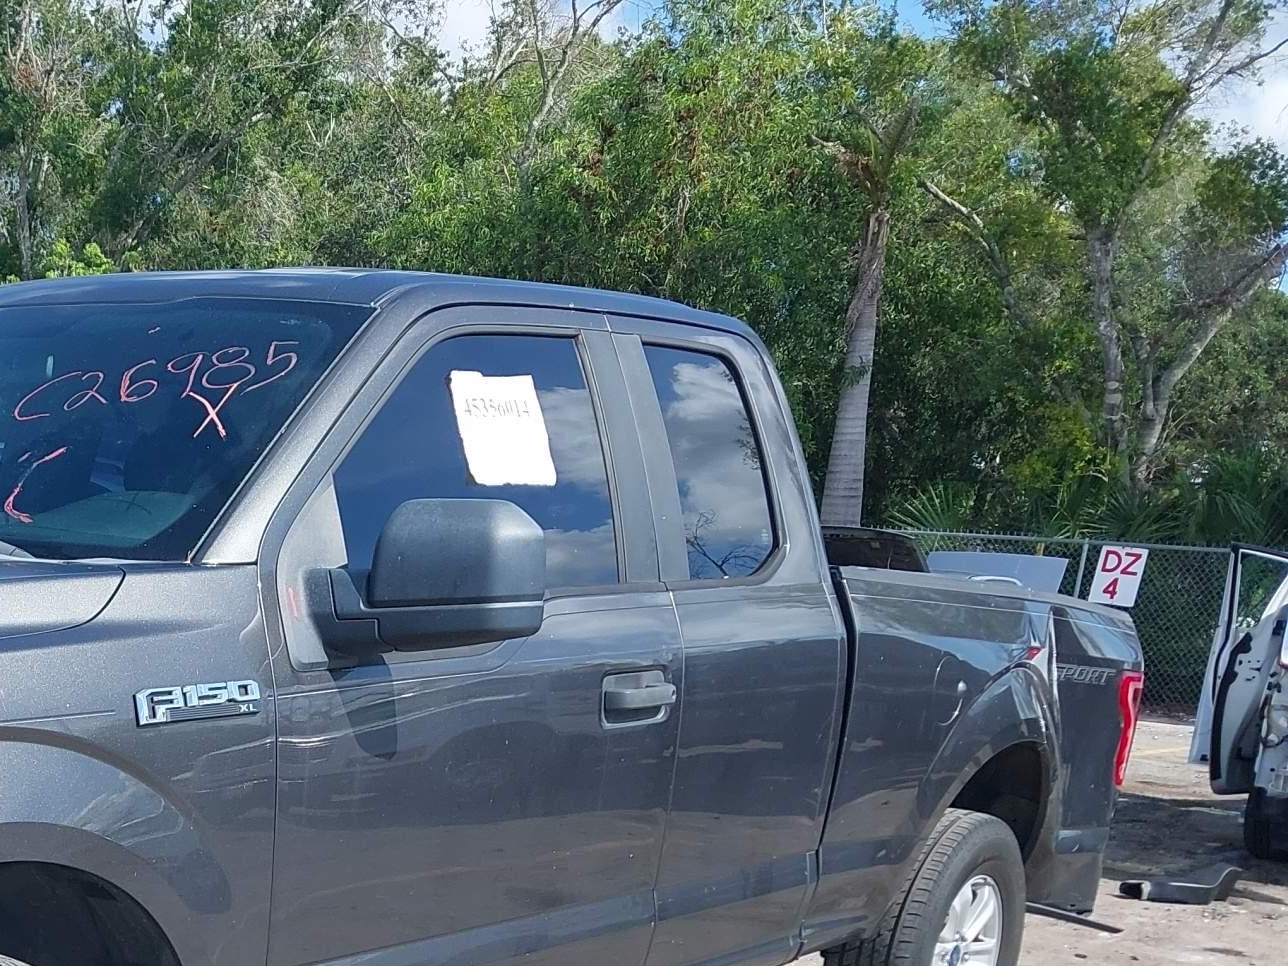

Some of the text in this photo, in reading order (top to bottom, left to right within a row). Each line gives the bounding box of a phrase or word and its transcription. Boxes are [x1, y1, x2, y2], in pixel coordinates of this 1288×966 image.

[1101, 549, 1143, 577] DZ
[1102, 577, 1120, 600] 4
[238, 703, 258, 713] XL
